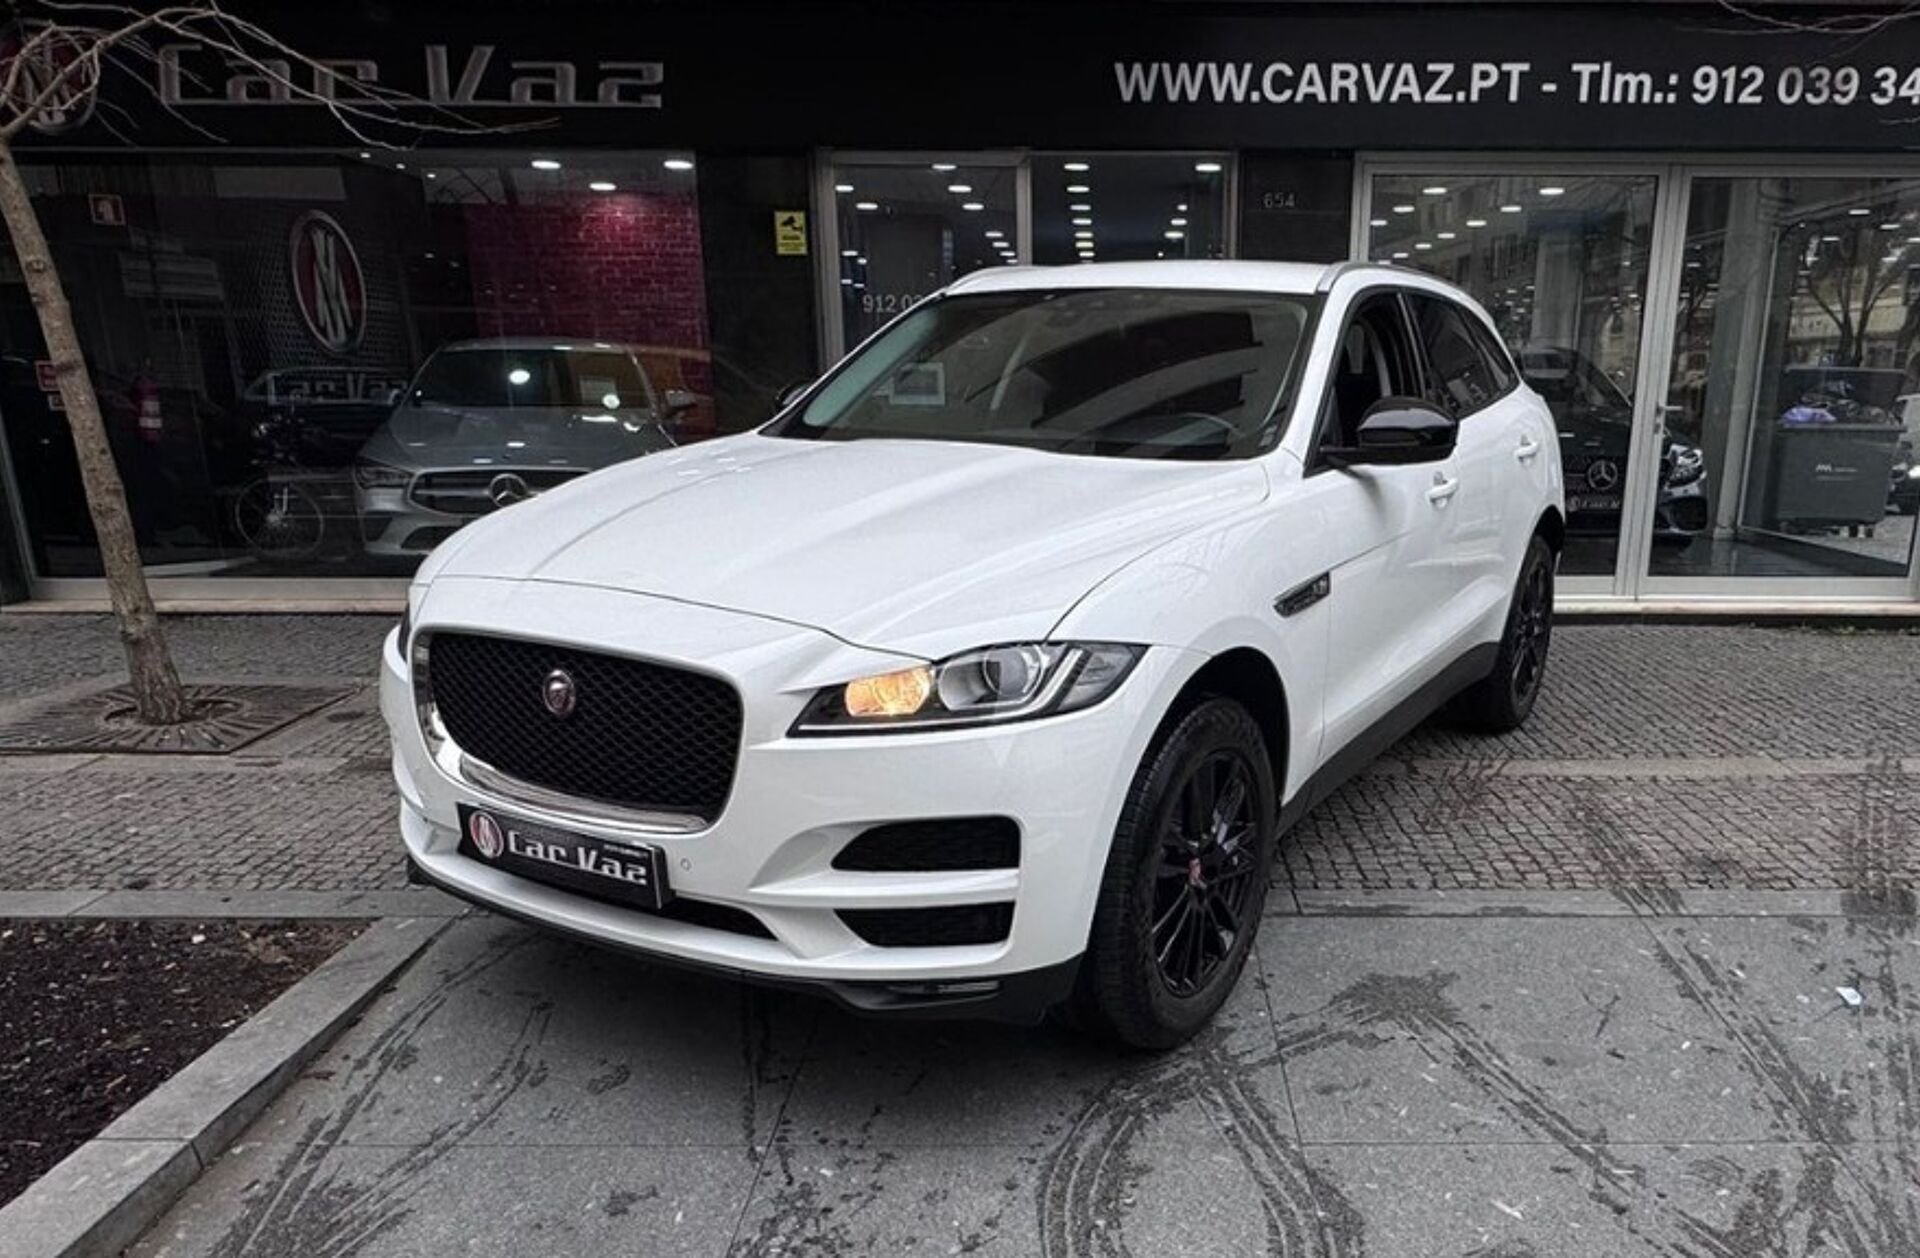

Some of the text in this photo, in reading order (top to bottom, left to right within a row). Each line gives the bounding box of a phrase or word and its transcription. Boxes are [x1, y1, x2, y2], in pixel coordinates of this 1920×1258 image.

[158, 44, 664, 107] Car Vaz
[1114, 61, 1529, 103] WWW.CARVAZ.PT
[1571, 62, 1678, 104] Tlm.:
[1691, 66, 1764, 104] 912
[1777, 66, 1858, 104] 039
[1263, 192, 1295, 208] 654
[862, 293, 896, 313] 912
[508, 829, 567, 863] Car
[577, 847, 647, 886] Vaz
